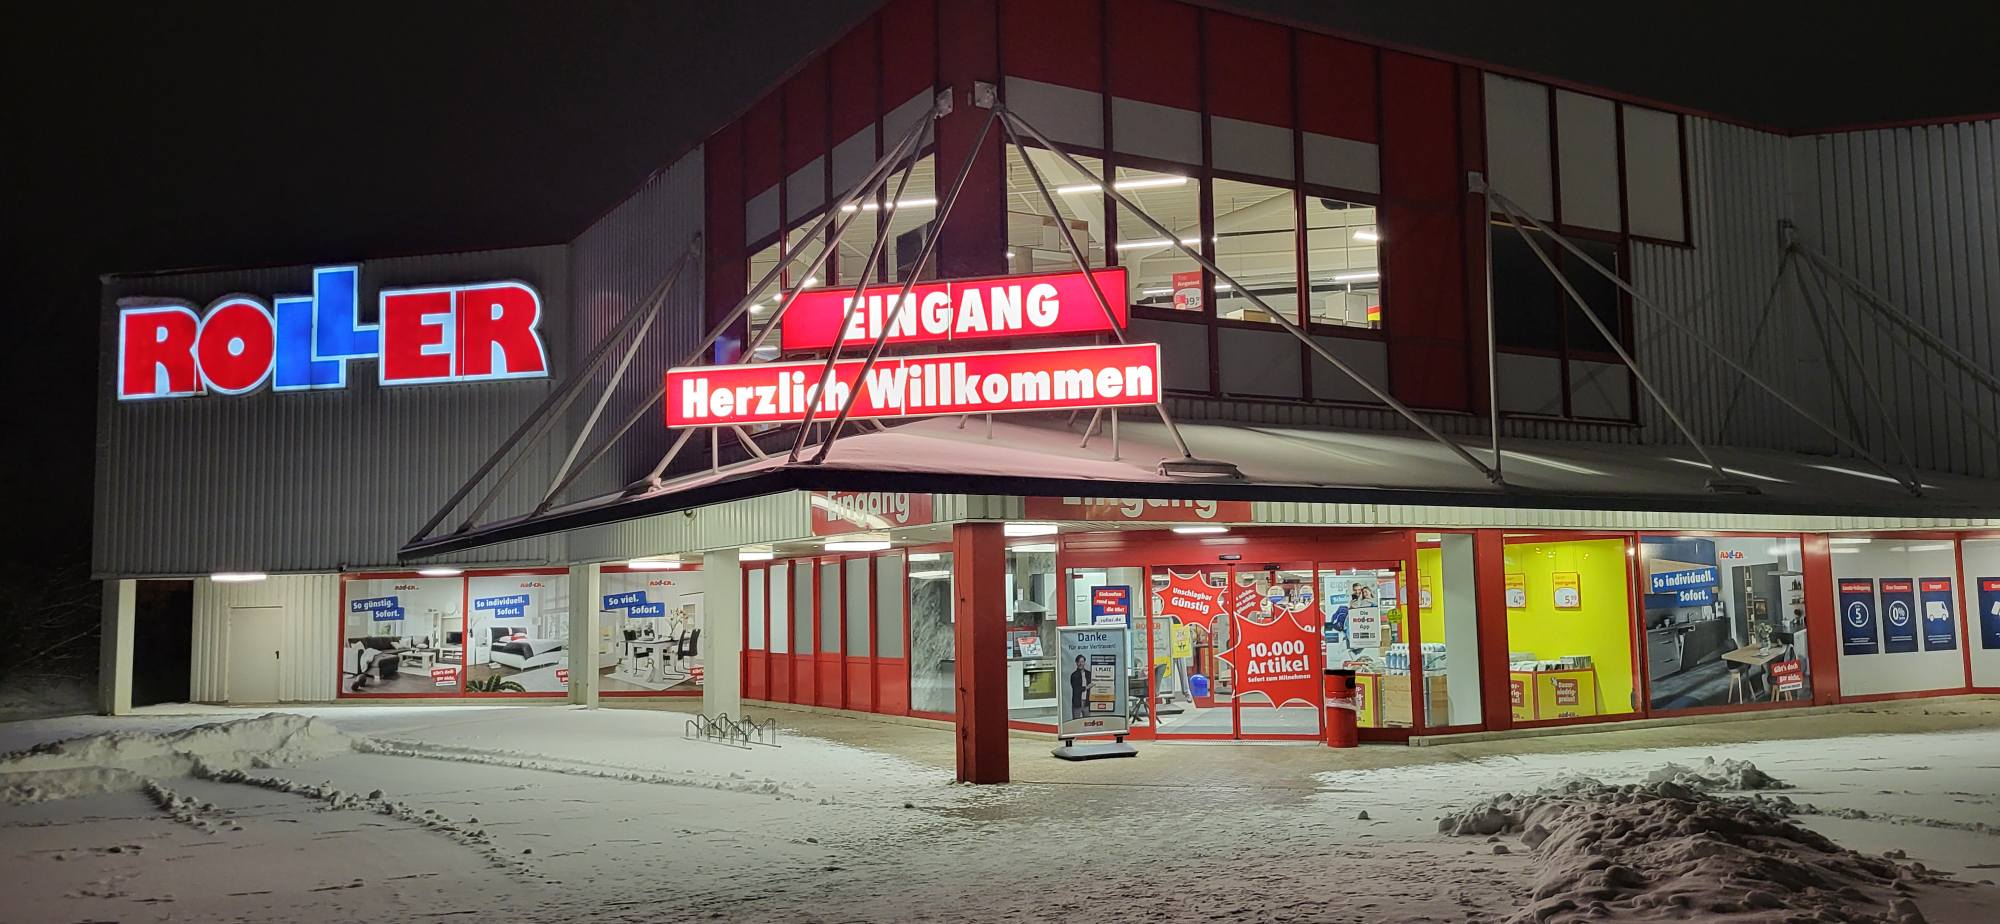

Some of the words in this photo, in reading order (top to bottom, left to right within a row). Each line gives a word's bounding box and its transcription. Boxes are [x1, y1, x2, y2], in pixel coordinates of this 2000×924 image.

[843, 283, 1060, 340] EINGANG
[118, 266, 548, 400] ROLLER
[682, 369, 850, 418] Herzlich
[865, 362, 1153, 409] Willkommen
[1653, 577, 1663, 588] So
[1665, 570, 1714, 586] individuell.
[608, 596, 619, 606] So
[620, 593, 640, 604] viel.
[1172, 587, 1213, 601] Unschlagbar
[1679, 589, 1709, 602] Sofort.
[353, 601, 362, 610] So
[364, 598, 394, 609] günstig.
[476, 600, 485, 608] So
[486, 596, 525, 607] individuell.
[1171, 597, 1210, 615] Günstig
[375, 609, 400, 618] Sofort.
[497, 607, 520, 616] Sofort.
[631, 605, 659, 615] Sofort.
[1855, 607, 1862, 620] 5
[1077, 632, 1108, 642] Danke
[1247, 640, 1305, 658] 10.000
[1247, 655, 1310, 675] Artikel
